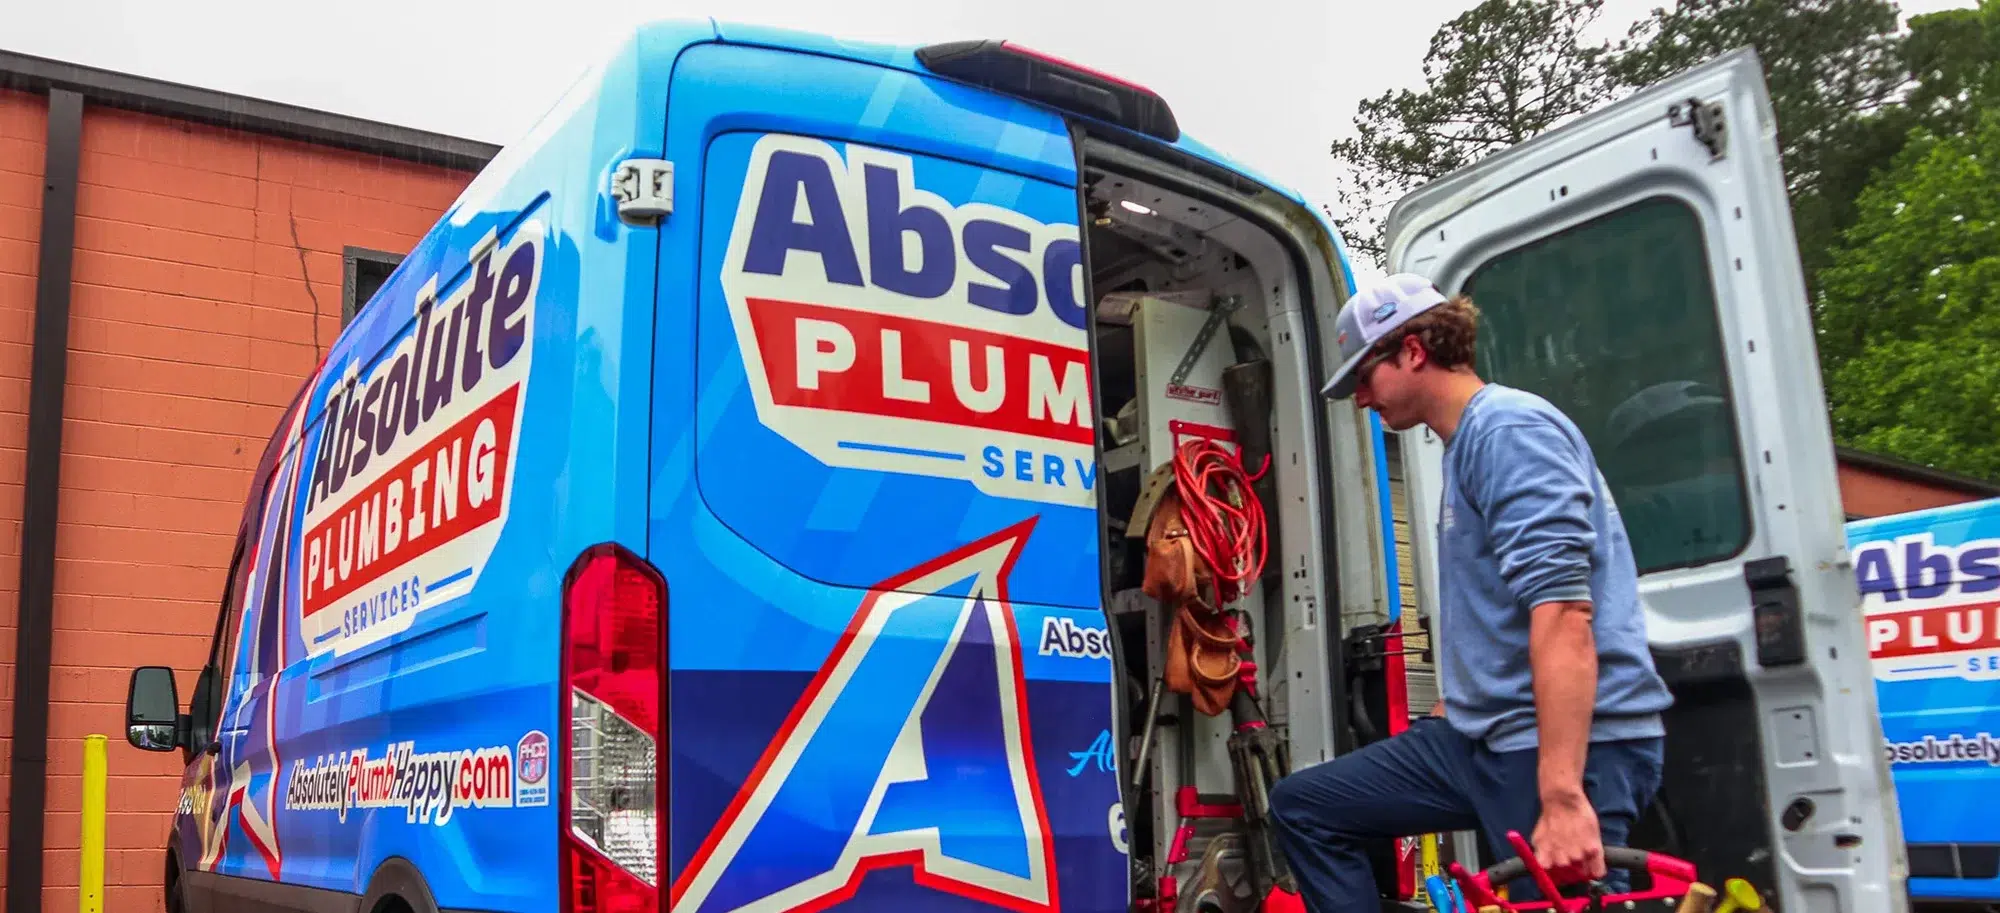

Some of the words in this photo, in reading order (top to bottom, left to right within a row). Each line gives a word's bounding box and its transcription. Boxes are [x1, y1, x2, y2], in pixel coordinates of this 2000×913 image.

[307, 241, 535, 515] Absolute
[795, 317, 1093, 428] PLUM
[982, 445, 1097, 490] SERV
[306, 417, 498, 600] PLUMBING
[343, 575, 420, 639] SERVICES
[1868, 607, 2000, 652] PLU
[287, 747, 510, 818] AbsolutelyPlumbHappy.com
